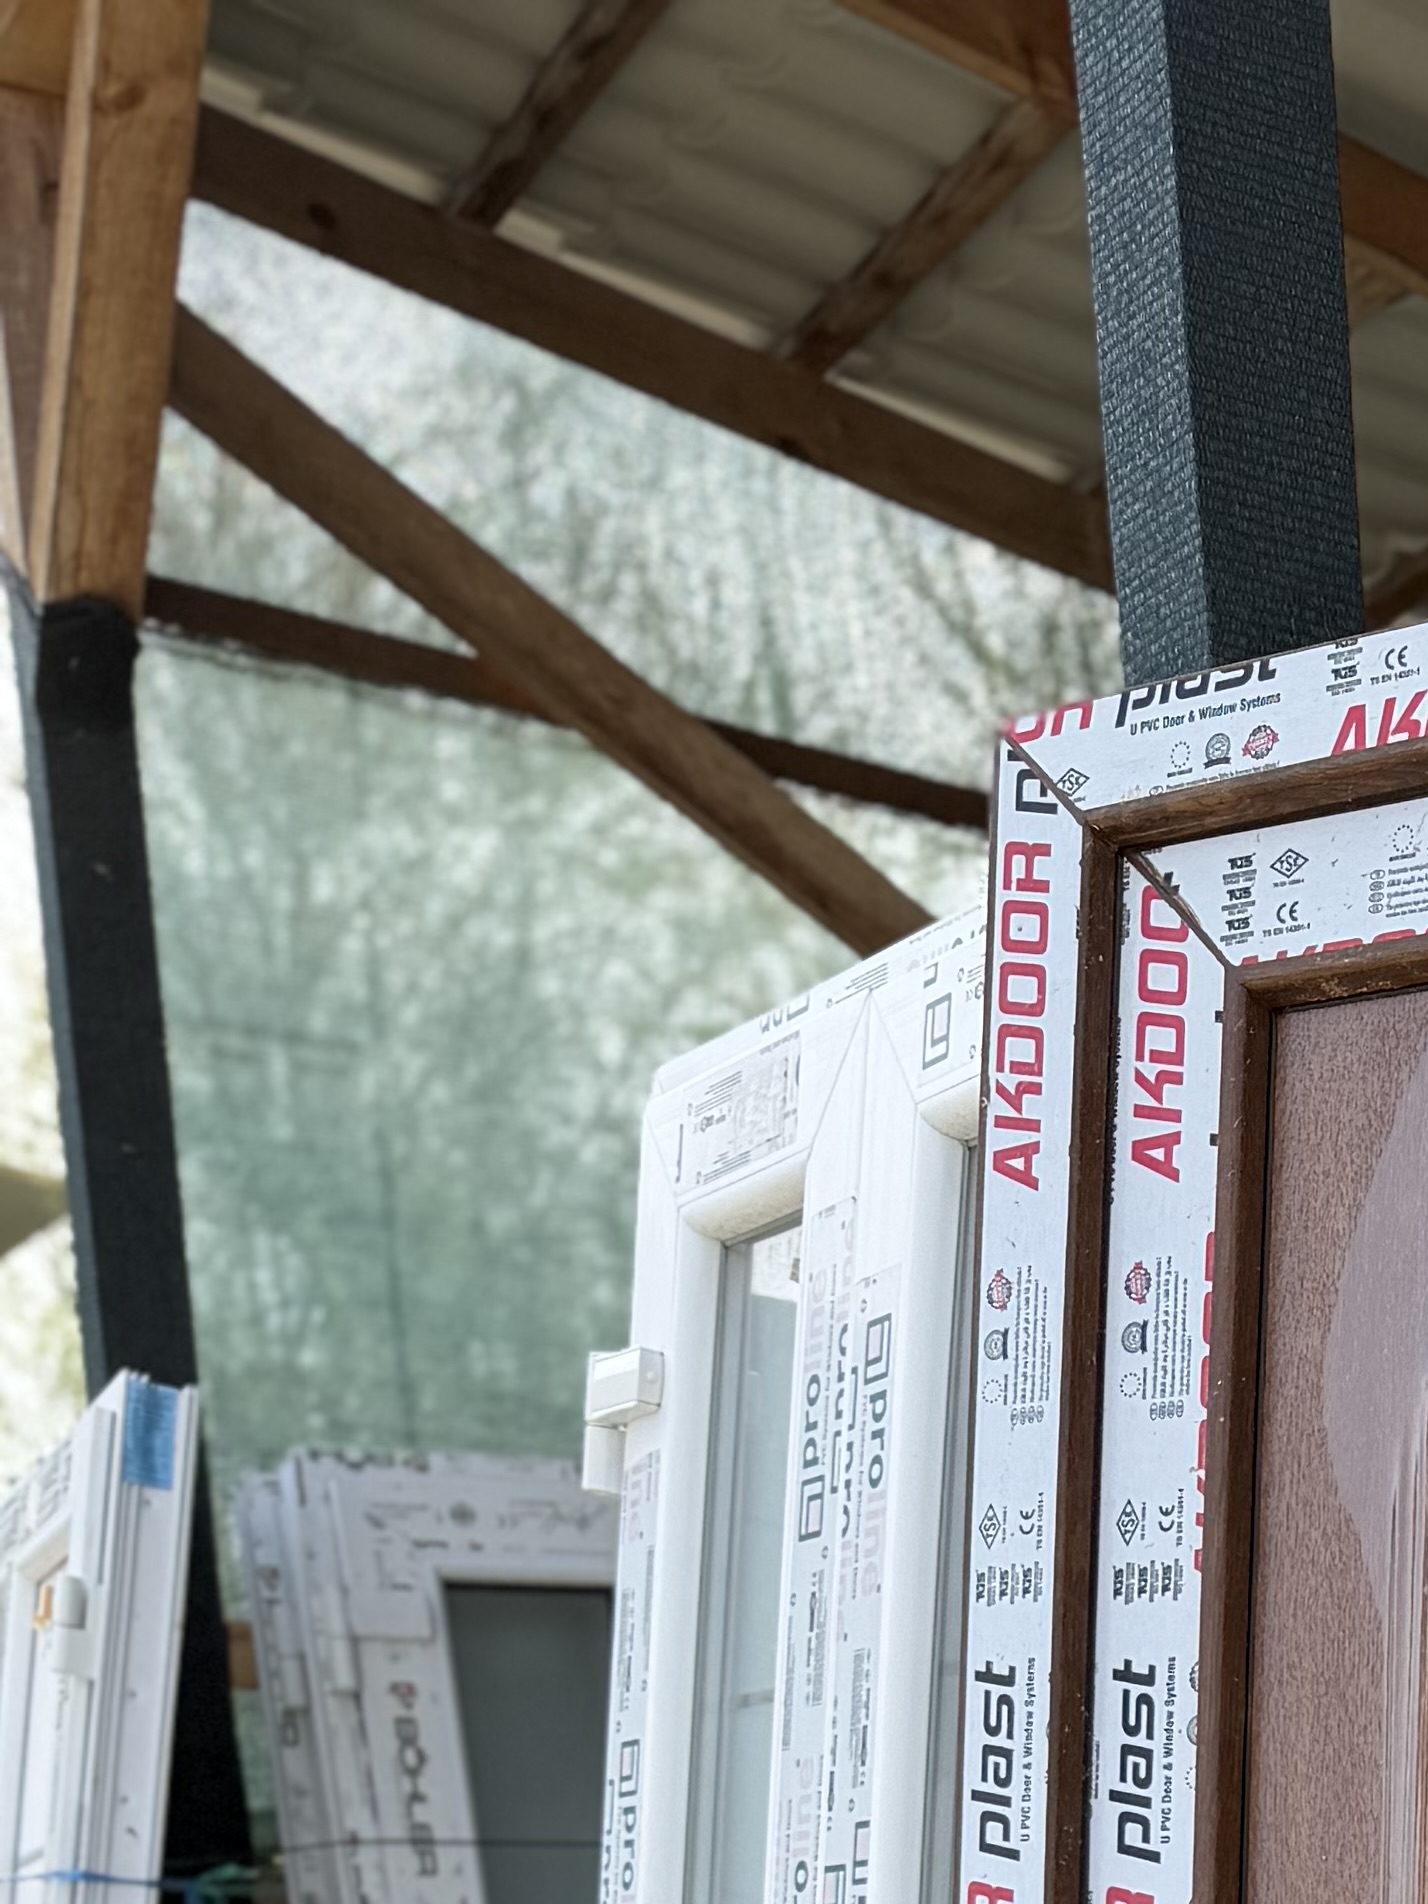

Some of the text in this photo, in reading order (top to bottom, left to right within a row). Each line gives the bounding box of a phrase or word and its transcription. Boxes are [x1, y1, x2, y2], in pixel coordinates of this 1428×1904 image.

[992, 841, 1051, 1191] AKDOOR
[1131, 883, 1192, 1183] AKDOO
[970, 1660, 1020, 1861] plast
[1108, 1658, 1161, 1864] plast
